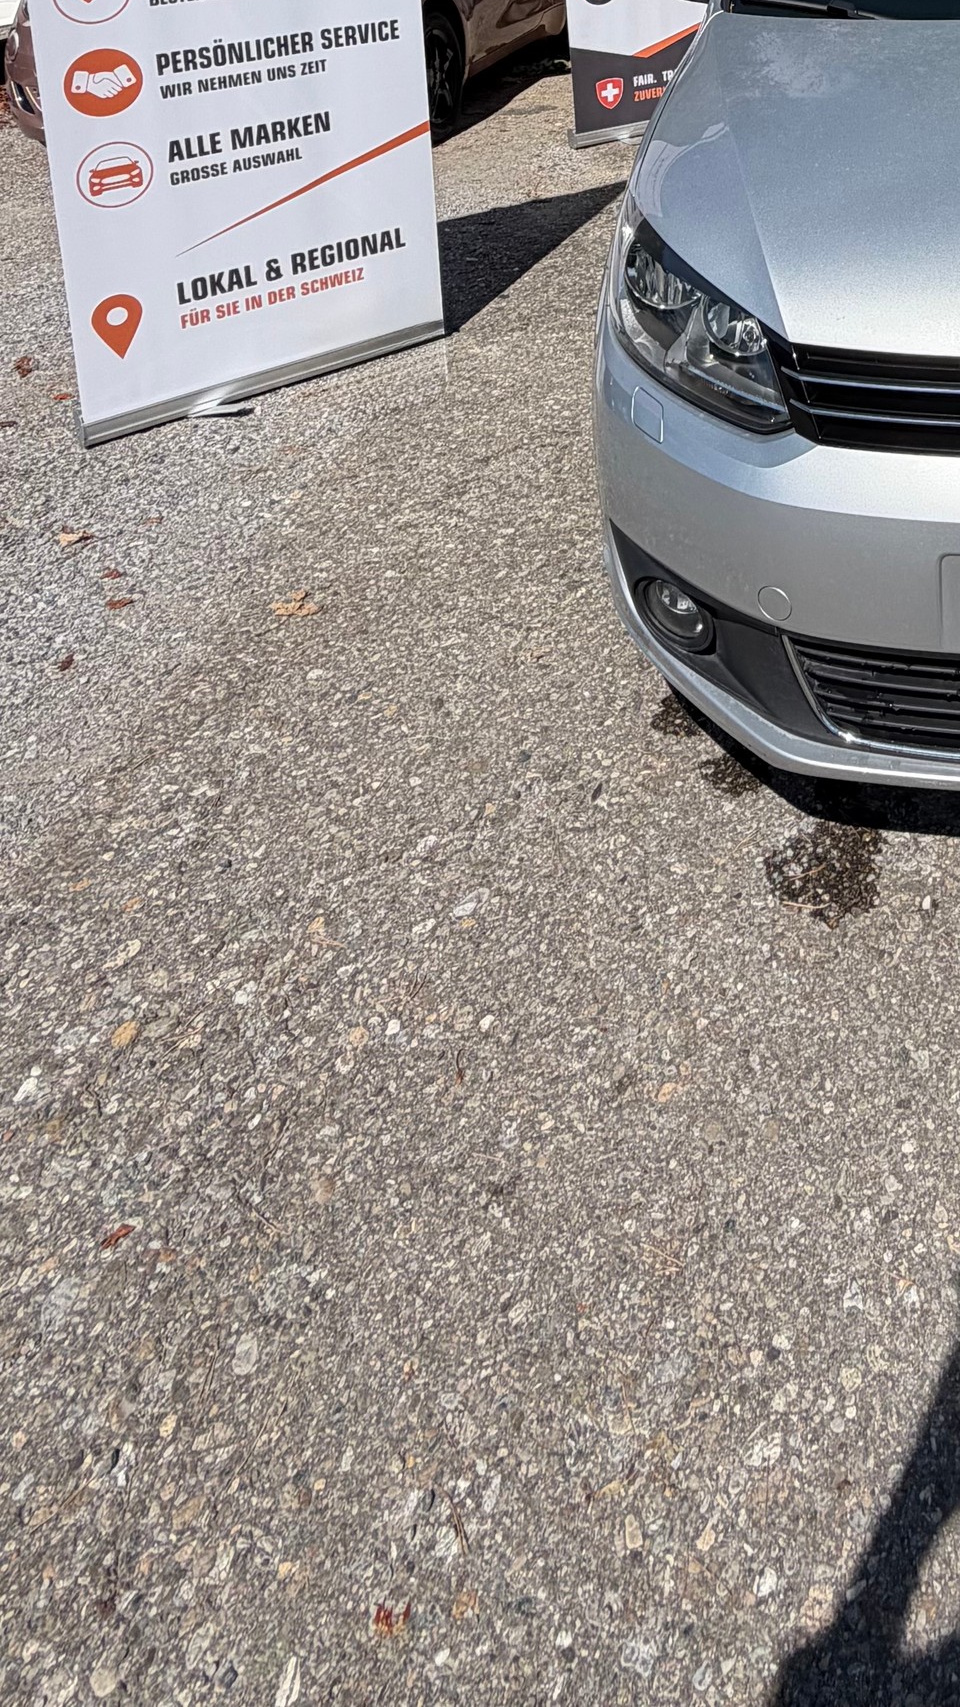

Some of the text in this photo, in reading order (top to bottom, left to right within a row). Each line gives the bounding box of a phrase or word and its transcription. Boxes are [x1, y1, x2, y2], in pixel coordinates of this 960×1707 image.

[155, 19, 400, 75] PERSÖNLICHER SERVICE
[160, 59, 327, 99] WIR NEHMEN UNS ZEIT
[633, 74, 657, 87] FAIR.
[634, 86, 666, 102] ZUVER
[167, 111, 331, 163] ALLE MARKEN
[170, 148, 303, 186] GROSSE AUSWAHL
[176, 227, 406, 305] LOKAL & REGIONAL
[180, 267, 365, 329] FÜR SIE IN DER SCHWEIZ
